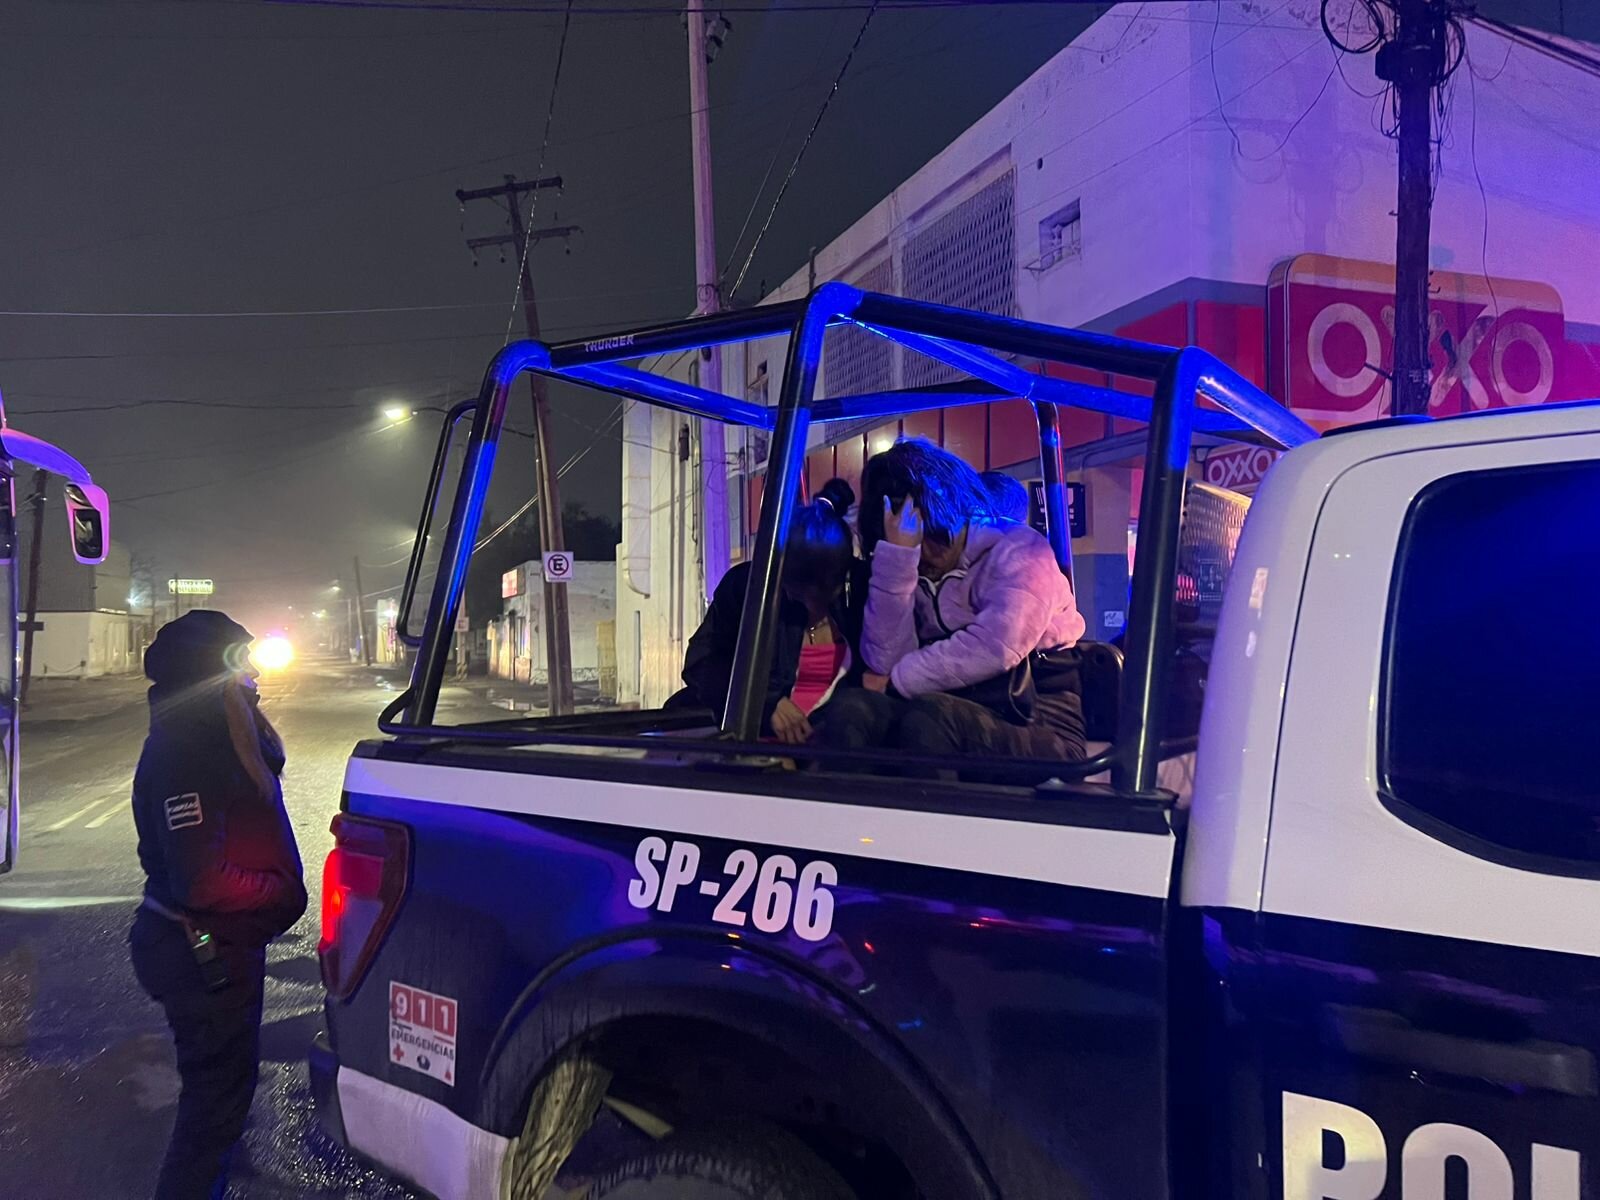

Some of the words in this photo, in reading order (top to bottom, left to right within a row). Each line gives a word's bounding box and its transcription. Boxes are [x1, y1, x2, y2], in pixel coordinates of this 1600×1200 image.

[583, 334, 635, 353] THUNDER
[1208, 448, 1272, 489] OXXO
[628, 836, 838, 942] SP-266
[395, 991, 449, 1031] 911
[391, 1026, 455, 1061] EMERGENCIAS
